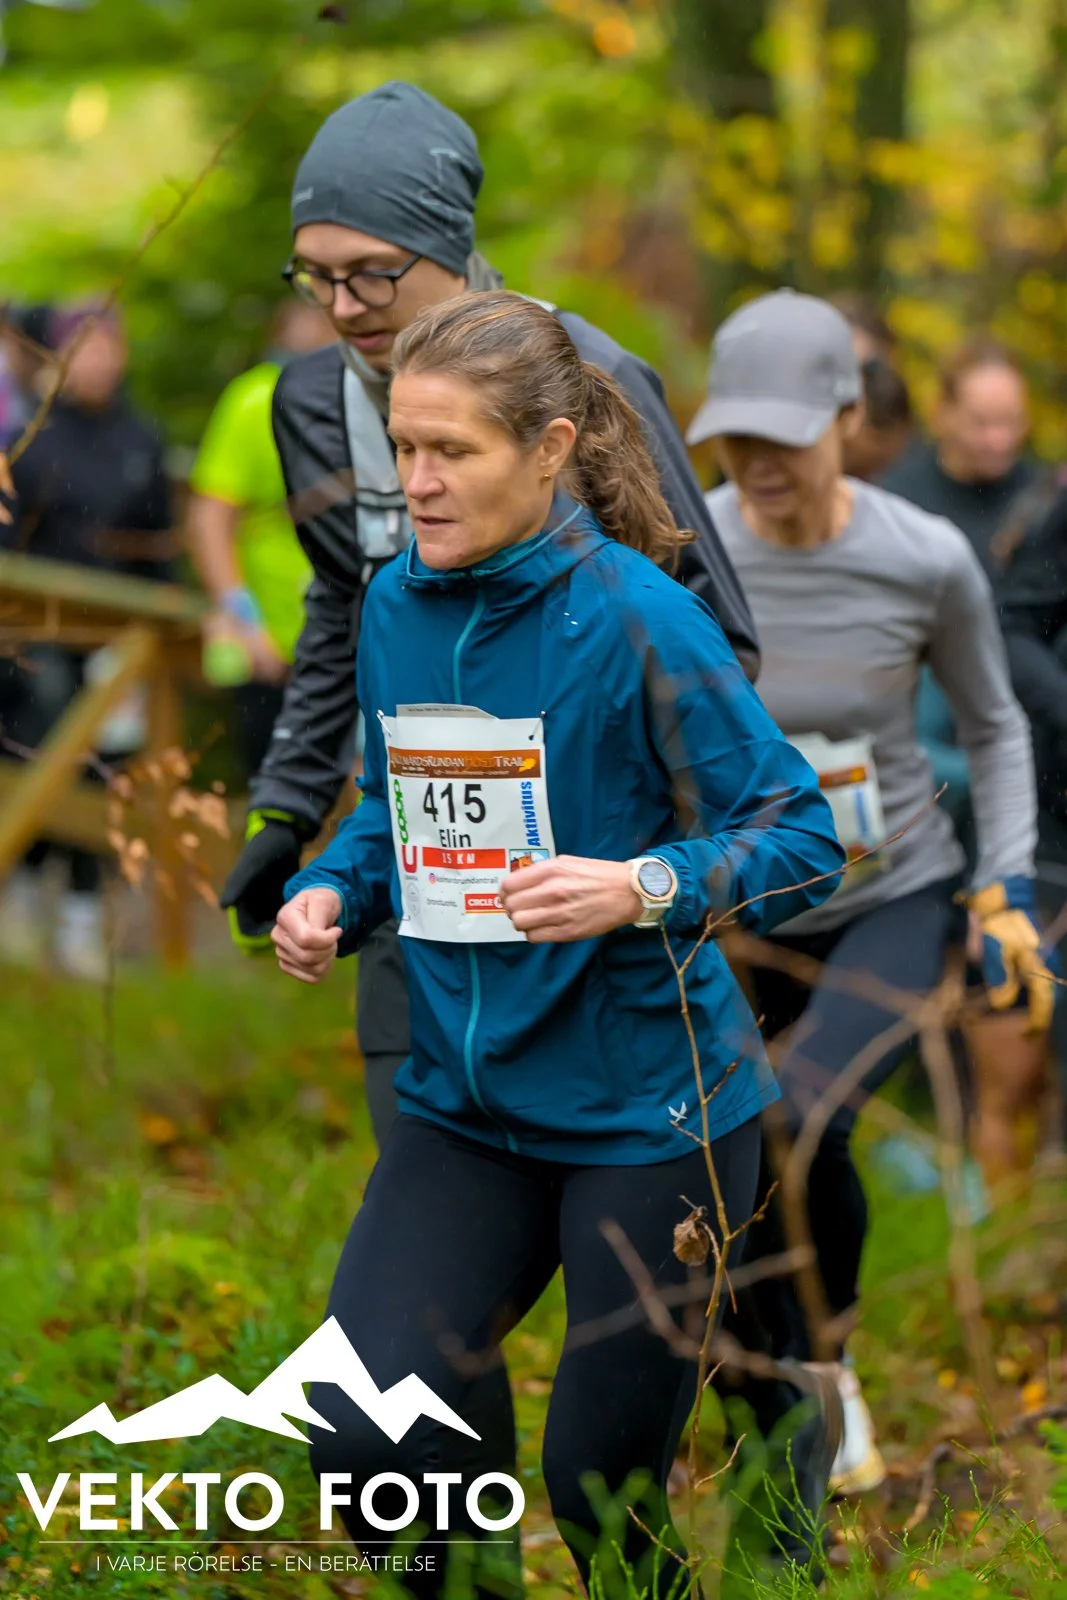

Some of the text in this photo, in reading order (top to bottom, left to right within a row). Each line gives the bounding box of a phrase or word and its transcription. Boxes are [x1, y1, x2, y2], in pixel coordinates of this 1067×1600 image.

[423, 782, 487, 824] 415
[520, 781, 541, 847] Aktivitus
[439, 829, 472, 848] Elin
[401, 844, 419, 873] U
[442, 853, 452, 864] 15
[467, 898, 494, 907] CIRCLE
